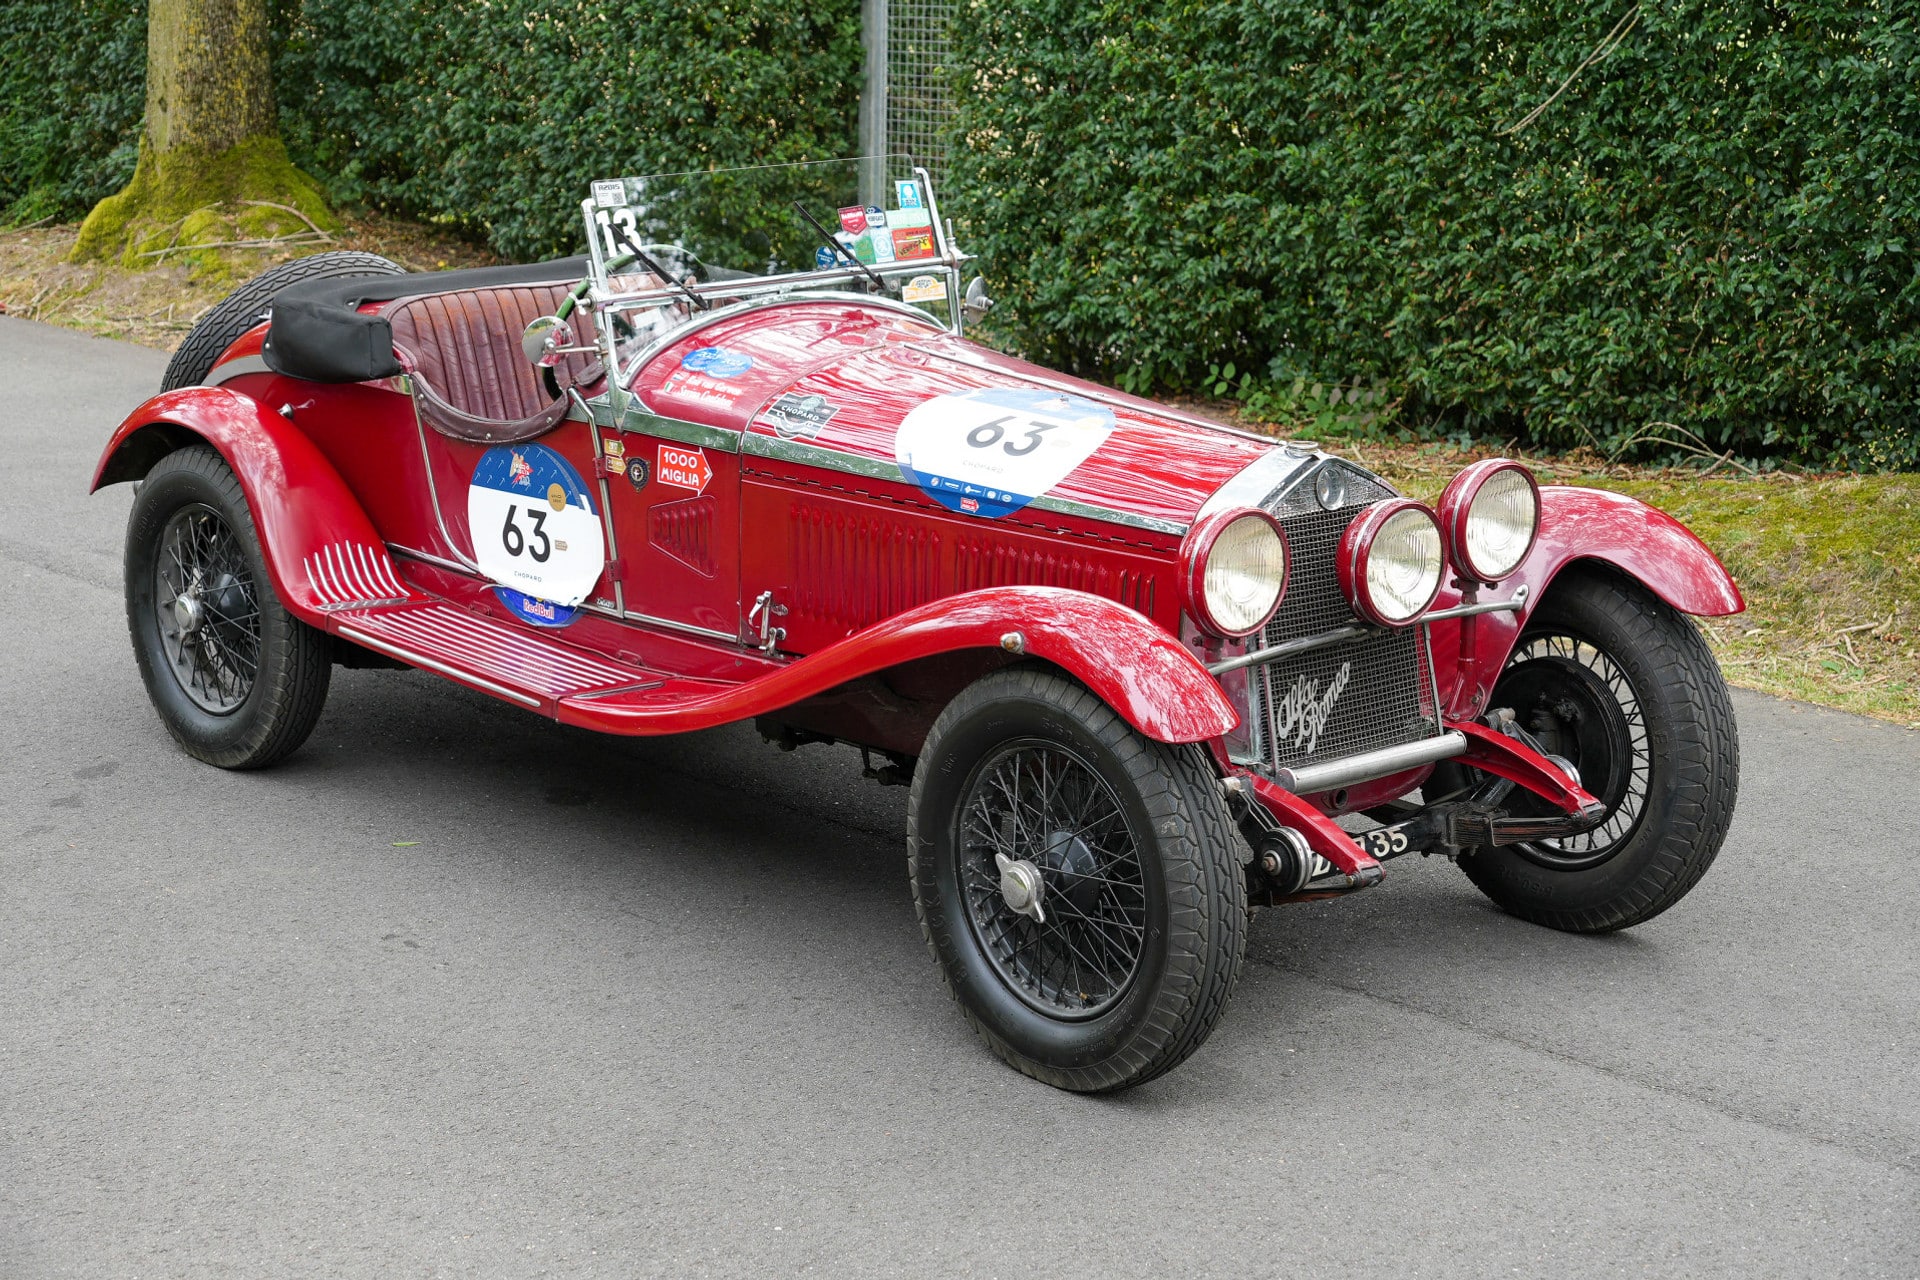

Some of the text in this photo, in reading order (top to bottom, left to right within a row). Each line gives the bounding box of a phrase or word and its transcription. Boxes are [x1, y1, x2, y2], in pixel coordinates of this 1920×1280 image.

[595, 208, 642, 258] 13
[781, 405, 820, 422] CHOPARD
[966, 415, 1059, 457] 63
[660, 467, 700, 486] MIGLIA
[663, 451, 698, 468] 1000
[502, 504, 551, 563] 63
[514, 570, 542, 583] CHOPARD
[1277, 674, 1318, 739] Alfa
[1295, 661, 1351, 754] Romeo
